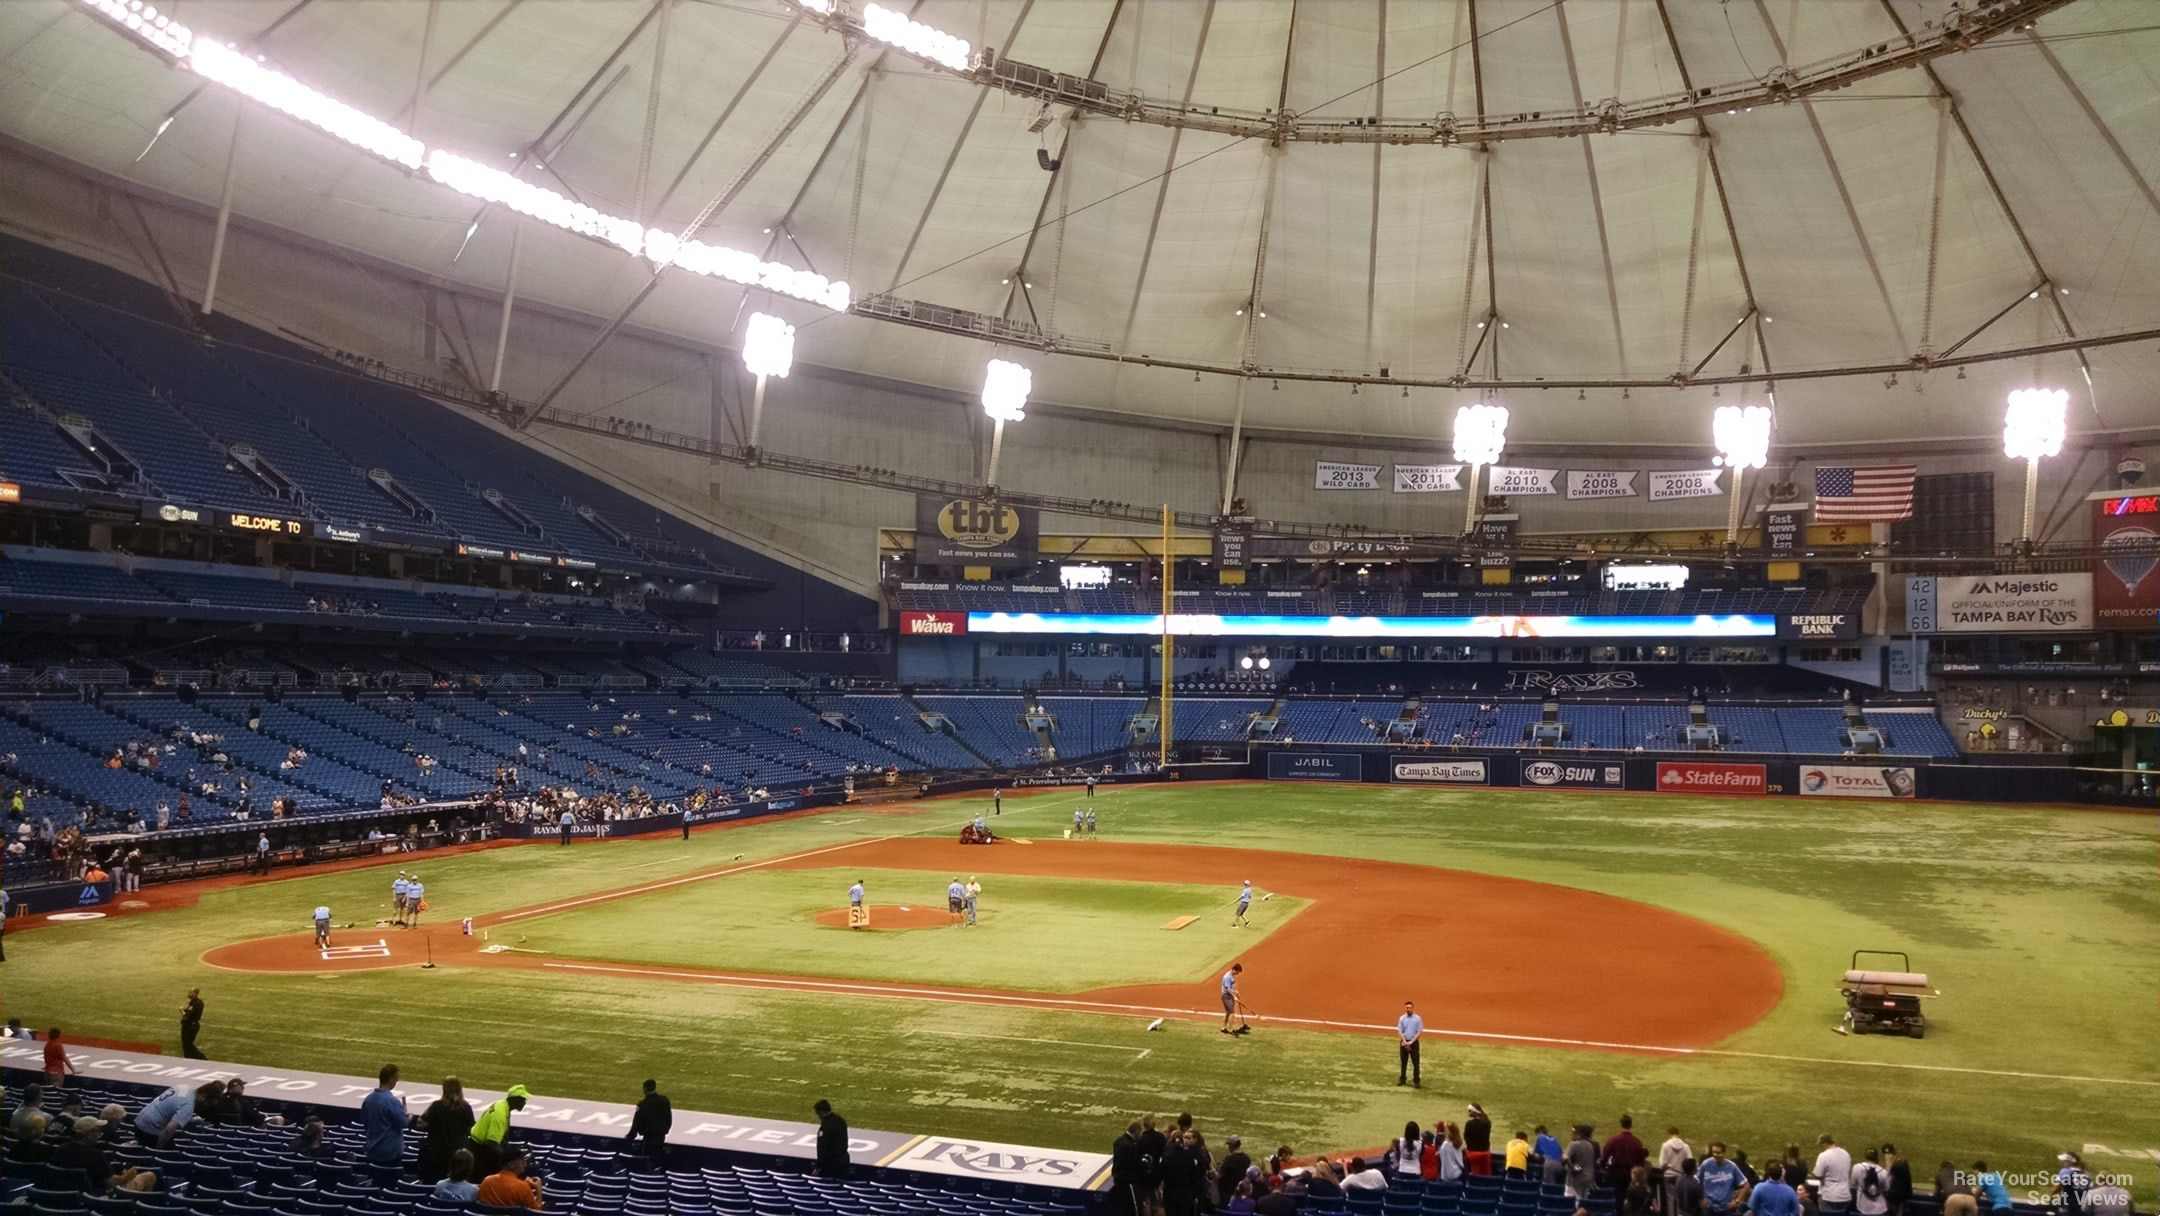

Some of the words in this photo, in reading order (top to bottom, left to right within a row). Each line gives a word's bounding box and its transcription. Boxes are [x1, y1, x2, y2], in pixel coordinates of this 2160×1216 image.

[1332, 472, 1364, 481] 2013
[1411, 474, 1443, 483] 2011
[1504, 476, 1539, 486] 2010
[1494, 485, 1548, 493] CHAMPIONS
[1582, 479, 1618, 489] 2008
[1666, 478, 1703, 490] 2008
[1572, 488, 1627, 496] CHAMPIONS
[1654, 488, 1713, 497] CHAMPIONS
[181, 510, 198, 520] SUN
[949, 500, 1009, 534] tbt
[1769, 515, 1792, 523] Fast
[231, 515, 281, 532] WELCOME
[287, 521, 301, 533] TO
[1772, 533, 1792, 542] you
[1224, 543, 1241, 551] you
[1480, 557, 1510, 565] buzz?
[901, 582, 949, 591] tampabay.com
[1012, 584, 1059, 593] tampabay.com
[1912, 580, 1930, 593] 42
[1994, 580, 2059, 596] Majestic
[1913, 599, 1928, 612] 12
[1952, 600, 1993, 608] OFFICIAL
[1995, 600, 2039, 608] UNIFORM
[2042, 599, 2055, 607] OF
[2058, 599, 2076, 607] THE
[1791, 615, 1846, 625] REPUBLIC
[1952, 611, 2002, 623] TAMPA
[2007, 611, 2036, 623] BAY
[911, 619, 954, 633] Wawa
[1912, 616, 1930, 630] 66
[1802, 625, 1835, 634] BANK
[1964, 708, 2008, 720] Ducky's
[1295, 758, 1334, 766] JABIL
[1400, 766, 1431, 778] Tampa
[1432, 766, 1450, 779] Bay
[1452, 766, 1481, 777] Times
[1534, 766, 1556, 776] FOX
[1565, 767, 1596, 781] SUN
[1767, 784, 1783, 792] 370
[248, 1076, 317, 1092] TO
[909, 1141, 1076, 1176] RAYS
